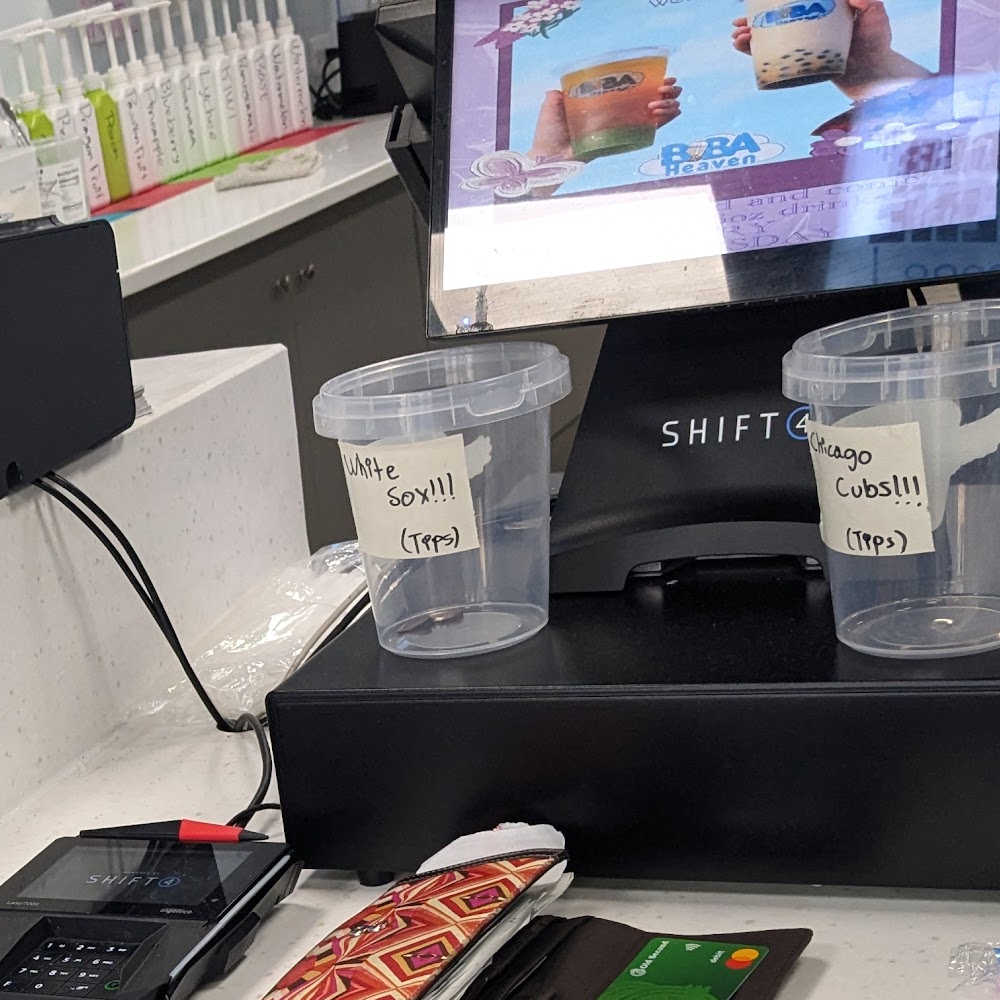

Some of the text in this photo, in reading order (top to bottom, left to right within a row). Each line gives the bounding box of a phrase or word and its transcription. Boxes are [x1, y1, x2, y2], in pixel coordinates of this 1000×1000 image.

[199, 69, 216, 140] Lychee
[80, 102, 94, 161] Dragon
[160, 79, 180, 164] Blueberry
[665, 154, 756, 176] Heaven
[810, 431, 873, 472] Chicago
[343, 452, 400, 481] White
[386, 472, 456, 507] Sox!!!
[835, 474, 922, 507] Cubs!!!
[846, 527, 908, 556] (Tips)
[61, 956, 71, 964] 5
[75, 943, 85, 951] 2
[48, 969, 58, 977] 8
[78, 971, 87, 979] 9
